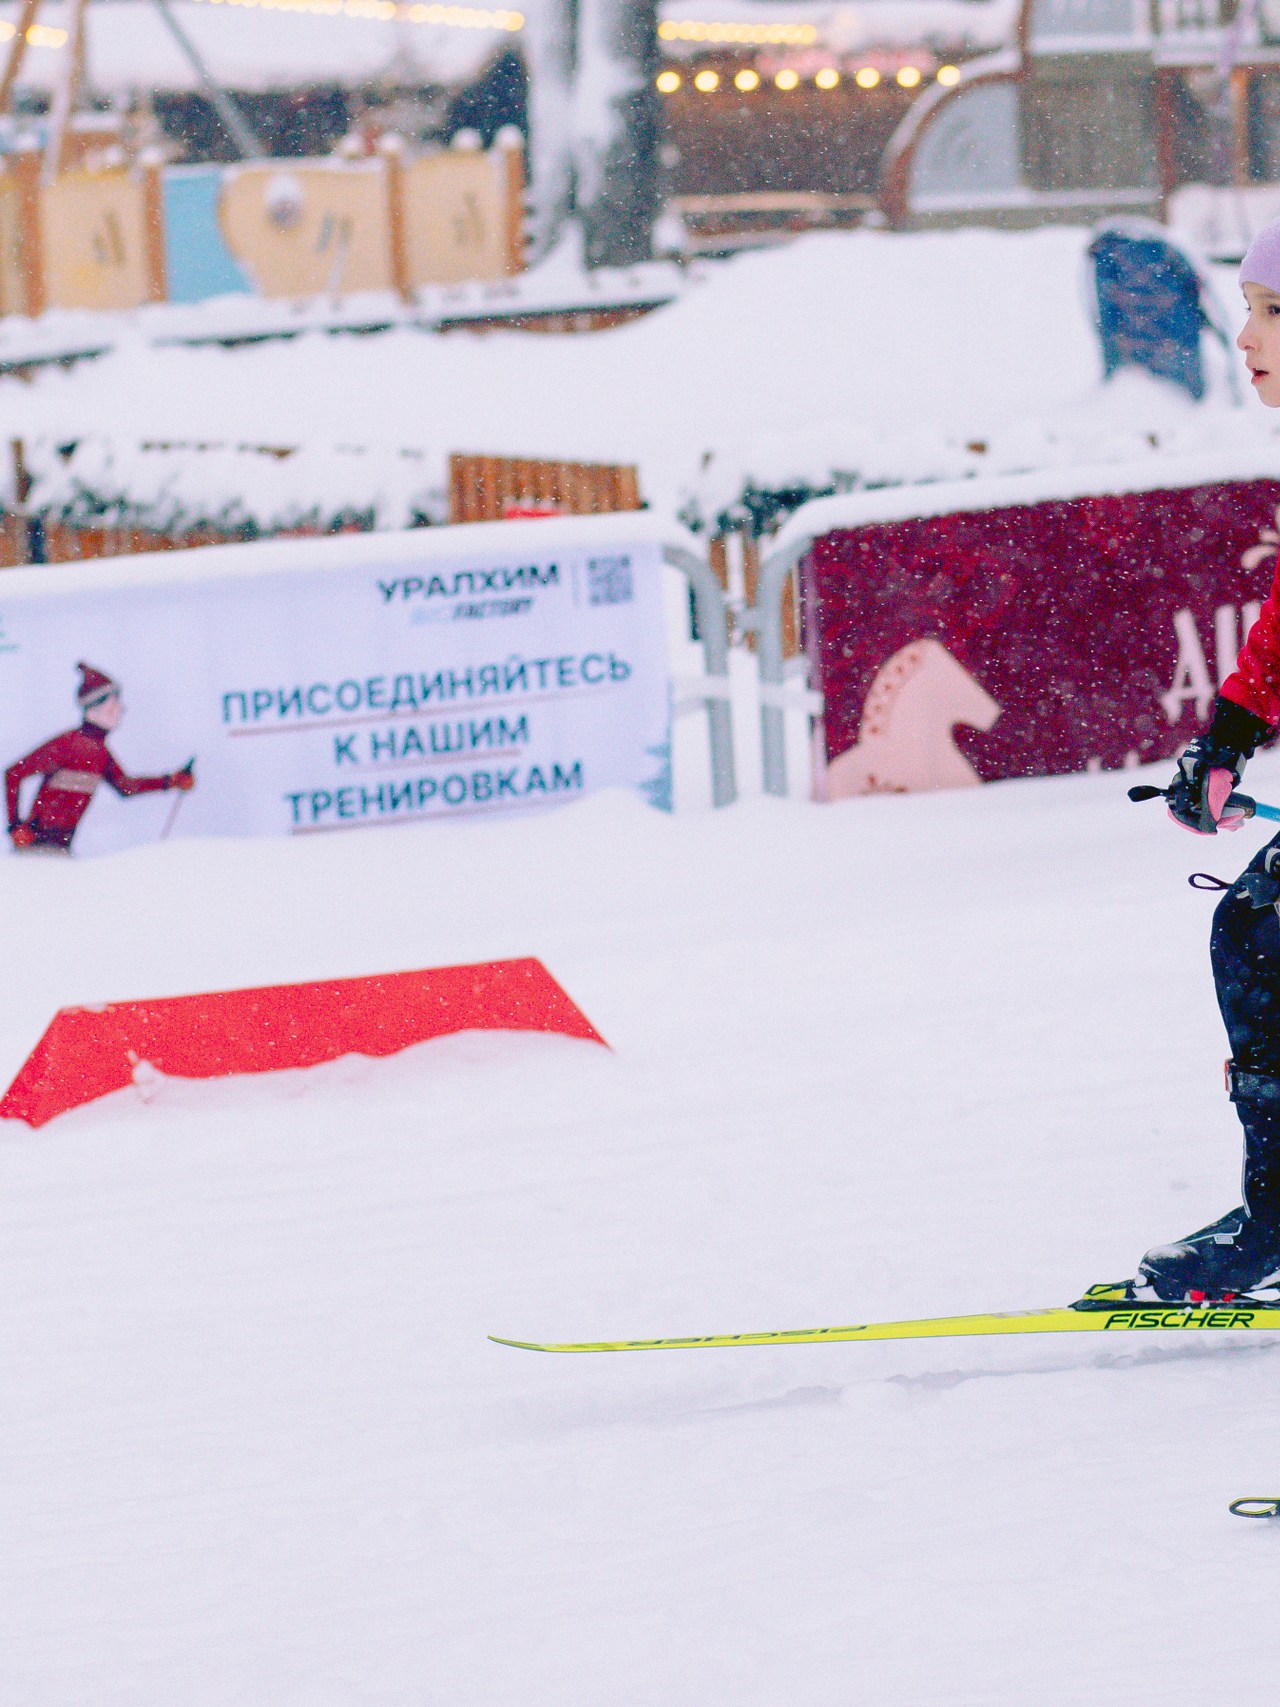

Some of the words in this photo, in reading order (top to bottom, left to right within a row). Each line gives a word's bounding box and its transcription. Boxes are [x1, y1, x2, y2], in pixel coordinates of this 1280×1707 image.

[377, 562, 559, 603] УРАЛХИМ
[222, 653, 632, 723] ПРИСОЕДИНЯЙТЕСЬ
[333, 733, 359, 766] К
[371, 714, 529, 760] НАШИМ
[285, 760, 584, 823] ТРЕНИРОВКАМ
[1104, 1311, 1255, 1330] FISCHER
